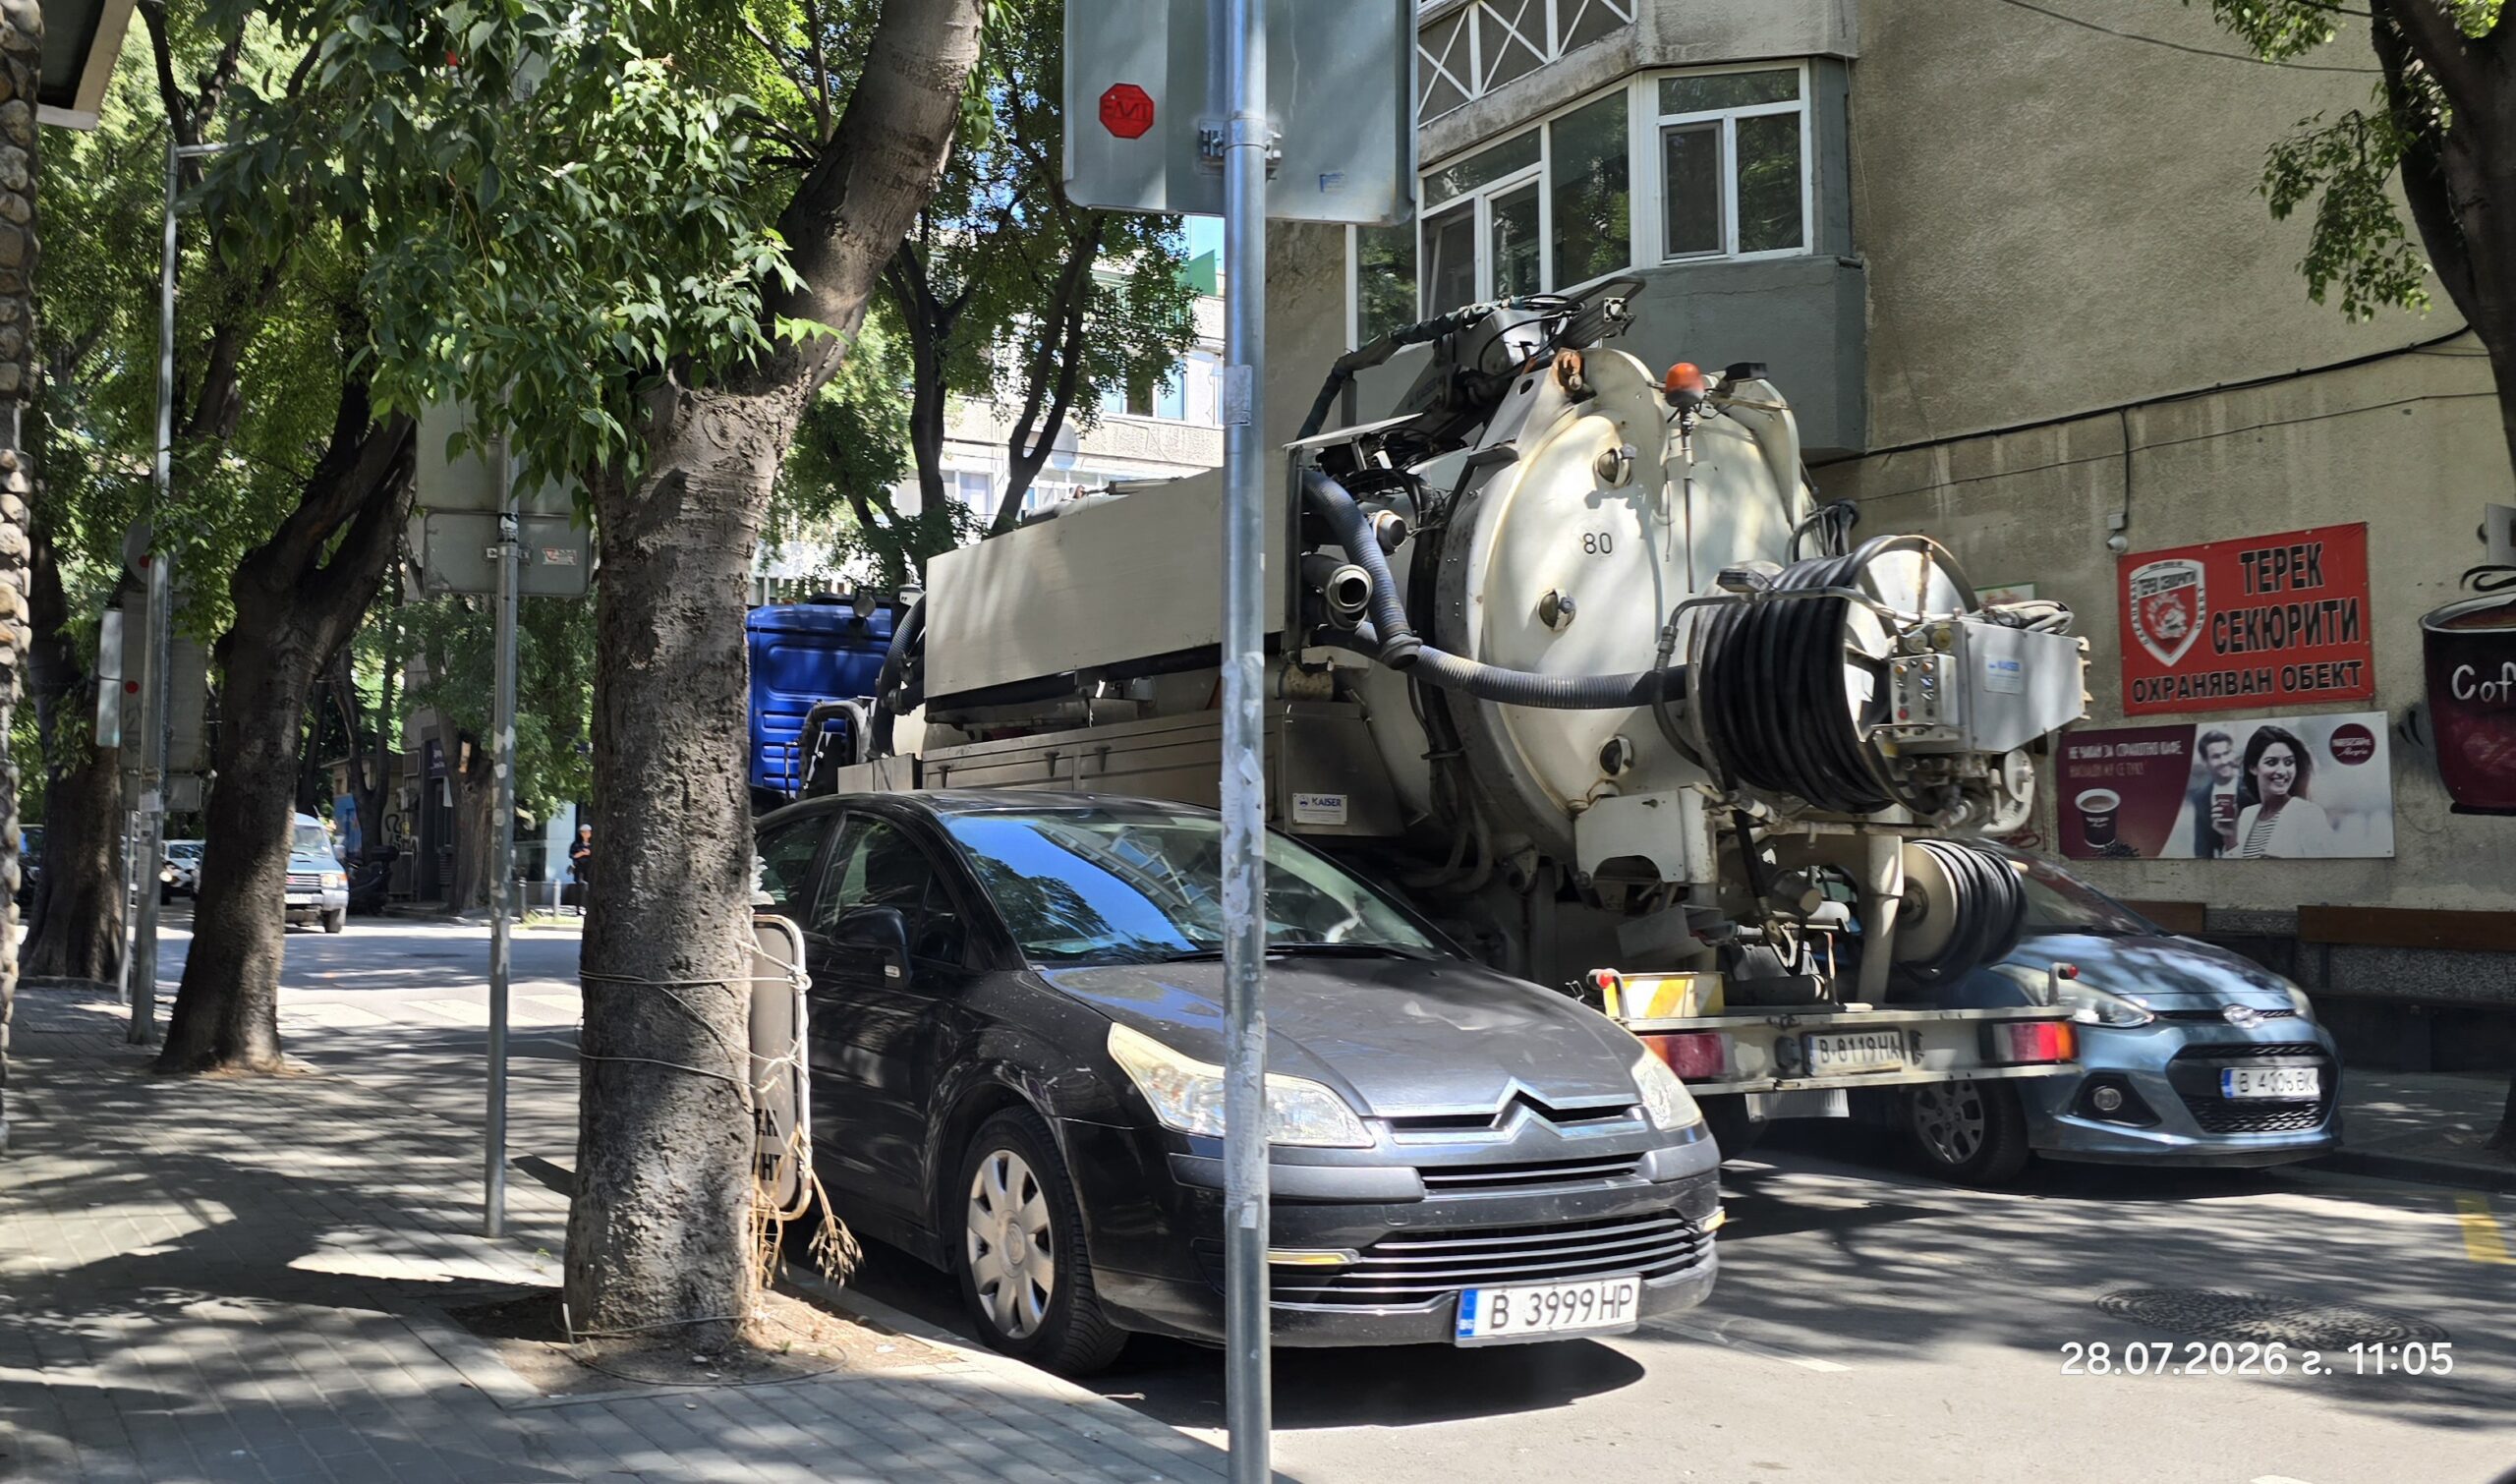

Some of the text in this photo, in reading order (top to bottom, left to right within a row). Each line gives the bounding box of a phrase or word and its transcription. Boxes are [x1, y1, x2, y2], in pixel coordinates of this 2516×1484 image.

[1583, 533, 1613, 554] 80
[2240, 542, 2324, 596] ТЕРЕК
[2212, 598, 2360, 656] СЕКЮРИТИ
[2132, 660, 2363, 704] ОХРАНЯВАН ОБЕКТ
[1312, 797, 1343, 807] KAISER
